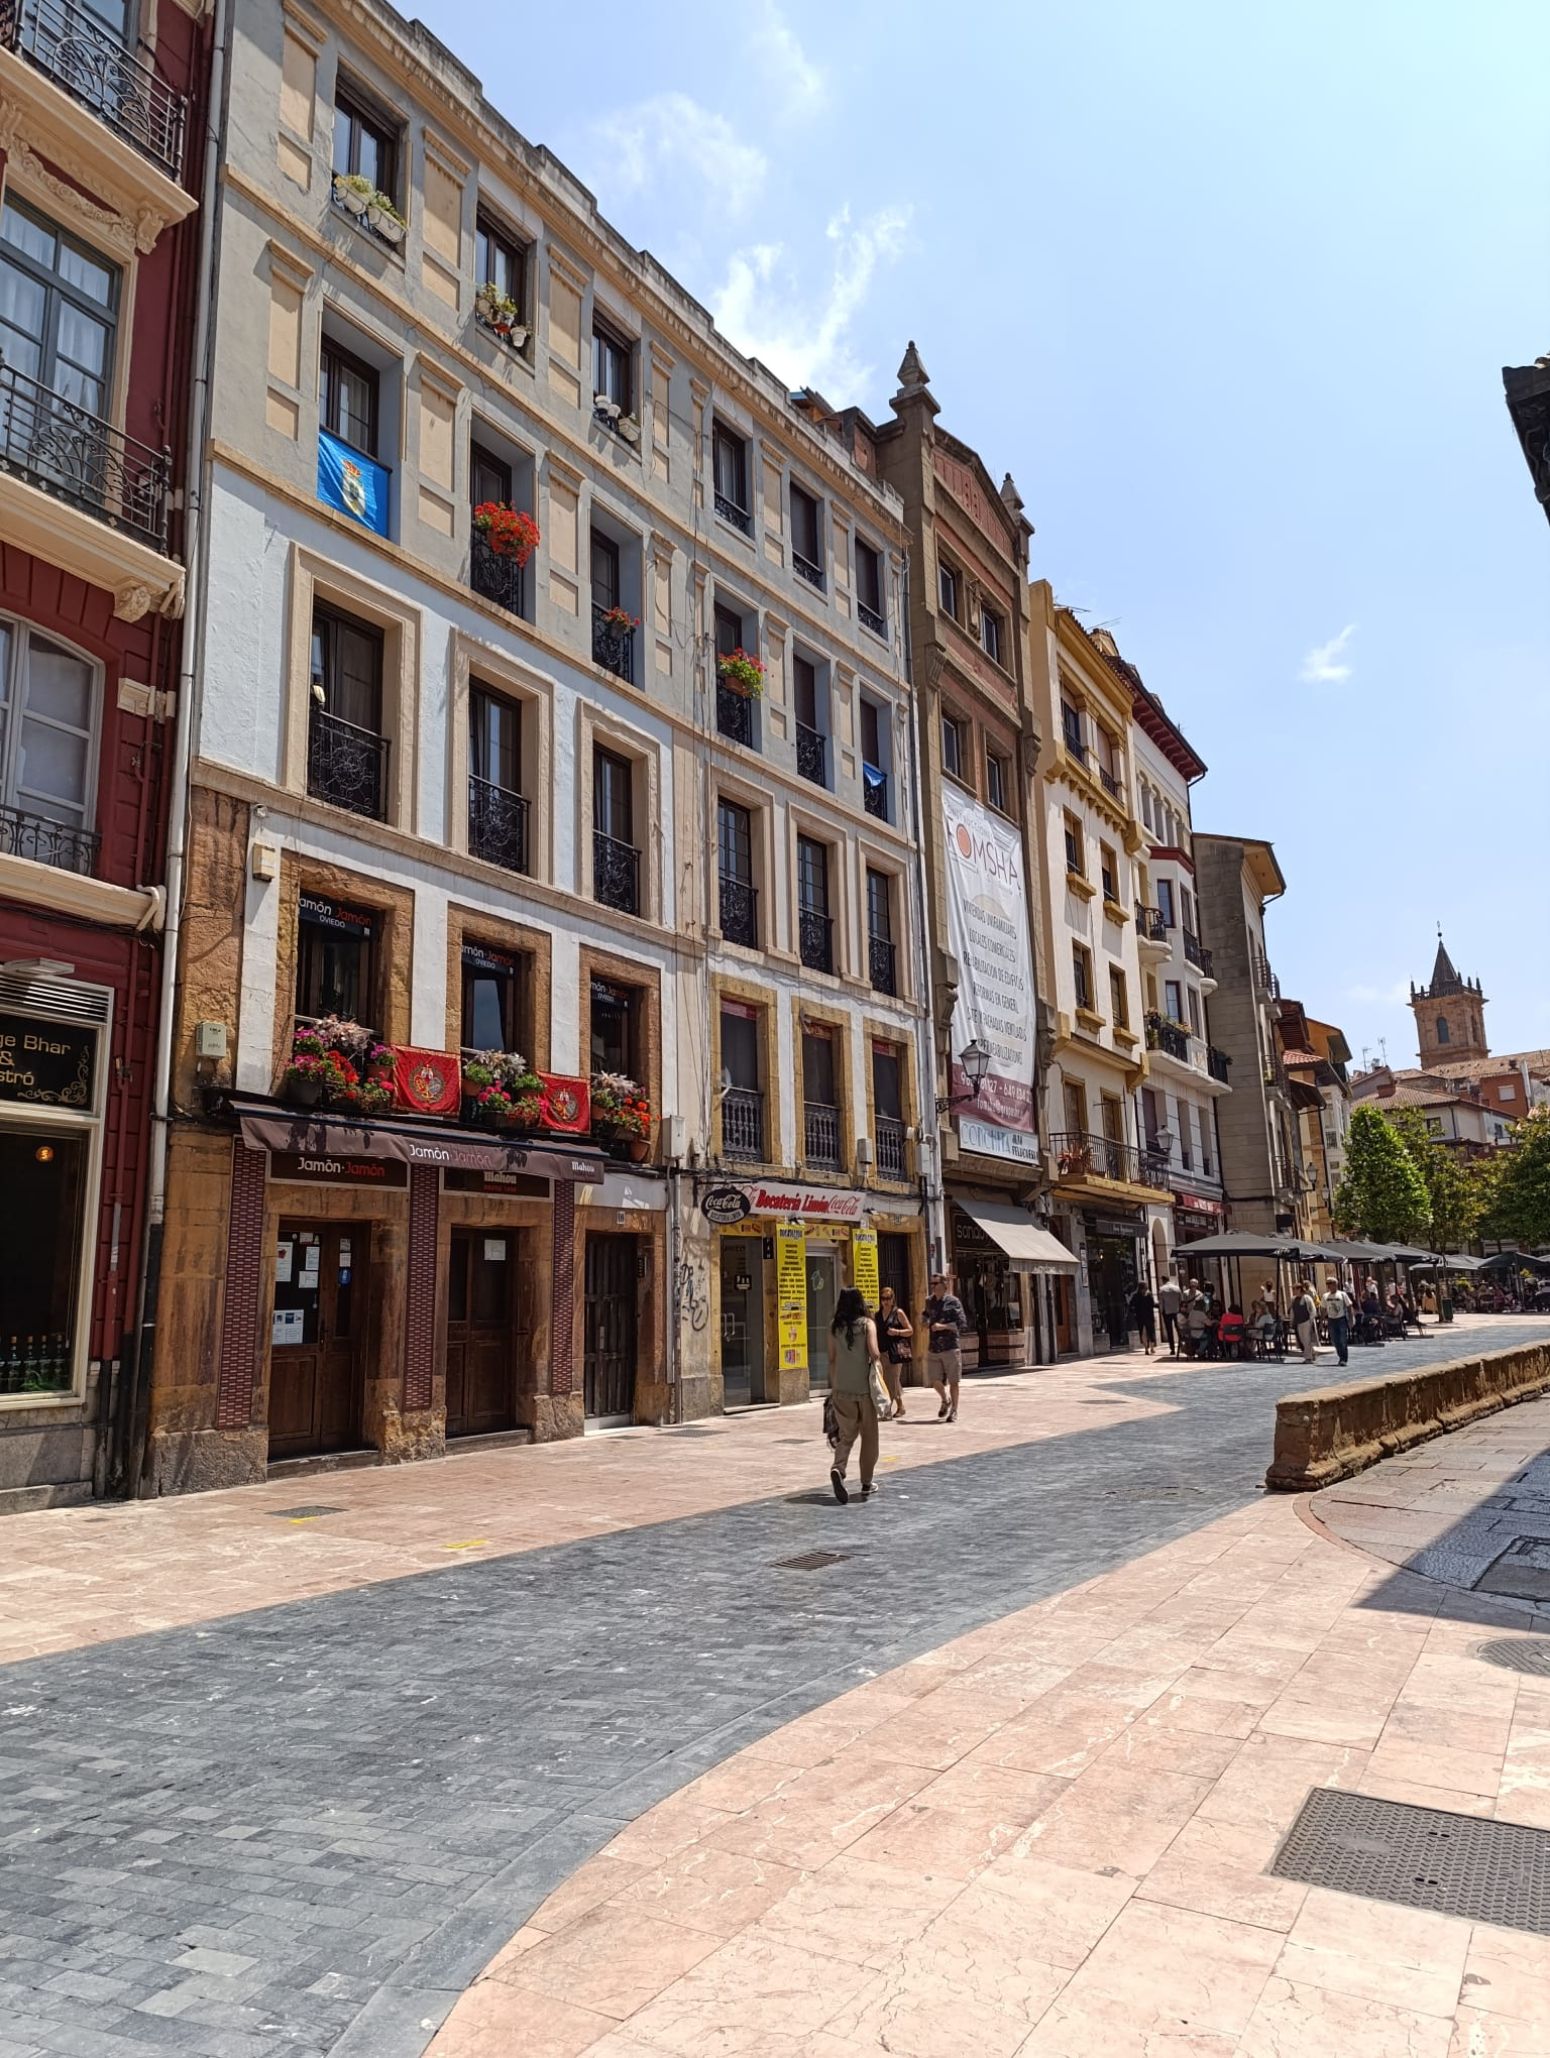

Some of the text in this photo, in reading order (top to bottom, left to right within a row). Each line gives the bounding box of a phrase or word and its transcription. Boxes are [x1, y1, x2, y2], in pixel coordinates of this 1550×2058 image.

[299, 897, 332, 916] amón
[319, 914, 346, 929] OVIEDO
[23, 1034, 71, 1055] Bhar
[410, 1144, 449, 1161] Jamón
[297, 1157, 385, 1177] Jamón Jamón
[571, 1161, 595, 1173] Mahou
[483, 1171, 517, 1185] Mahou
[755, 1189, 801, 1212] Bocatería
[801, 1194, 830, 1214] Limón
